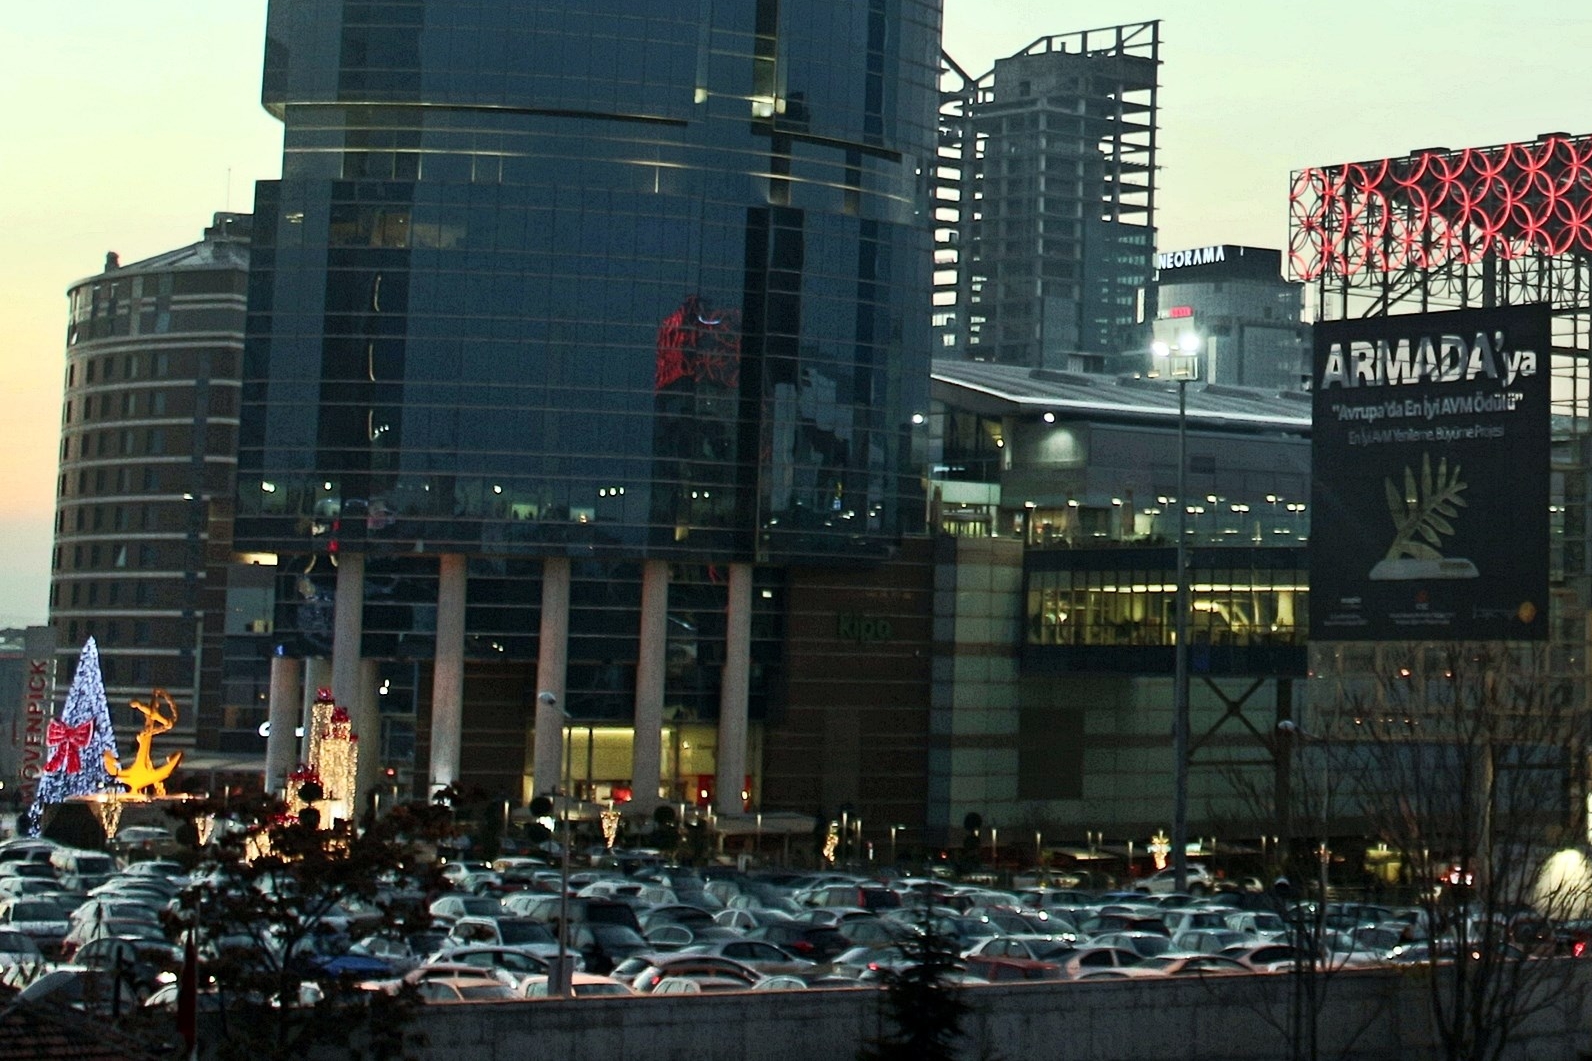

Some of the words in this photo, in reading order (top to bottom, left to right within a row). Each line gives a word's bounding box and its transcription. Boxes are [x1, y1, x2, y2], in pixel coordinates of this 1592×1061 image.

[1158, 245, 1225, 270] NEORAMA
[1320, 331, 1537, 390] ARMADA'ya
[1404, 400, 1422, 417] En
